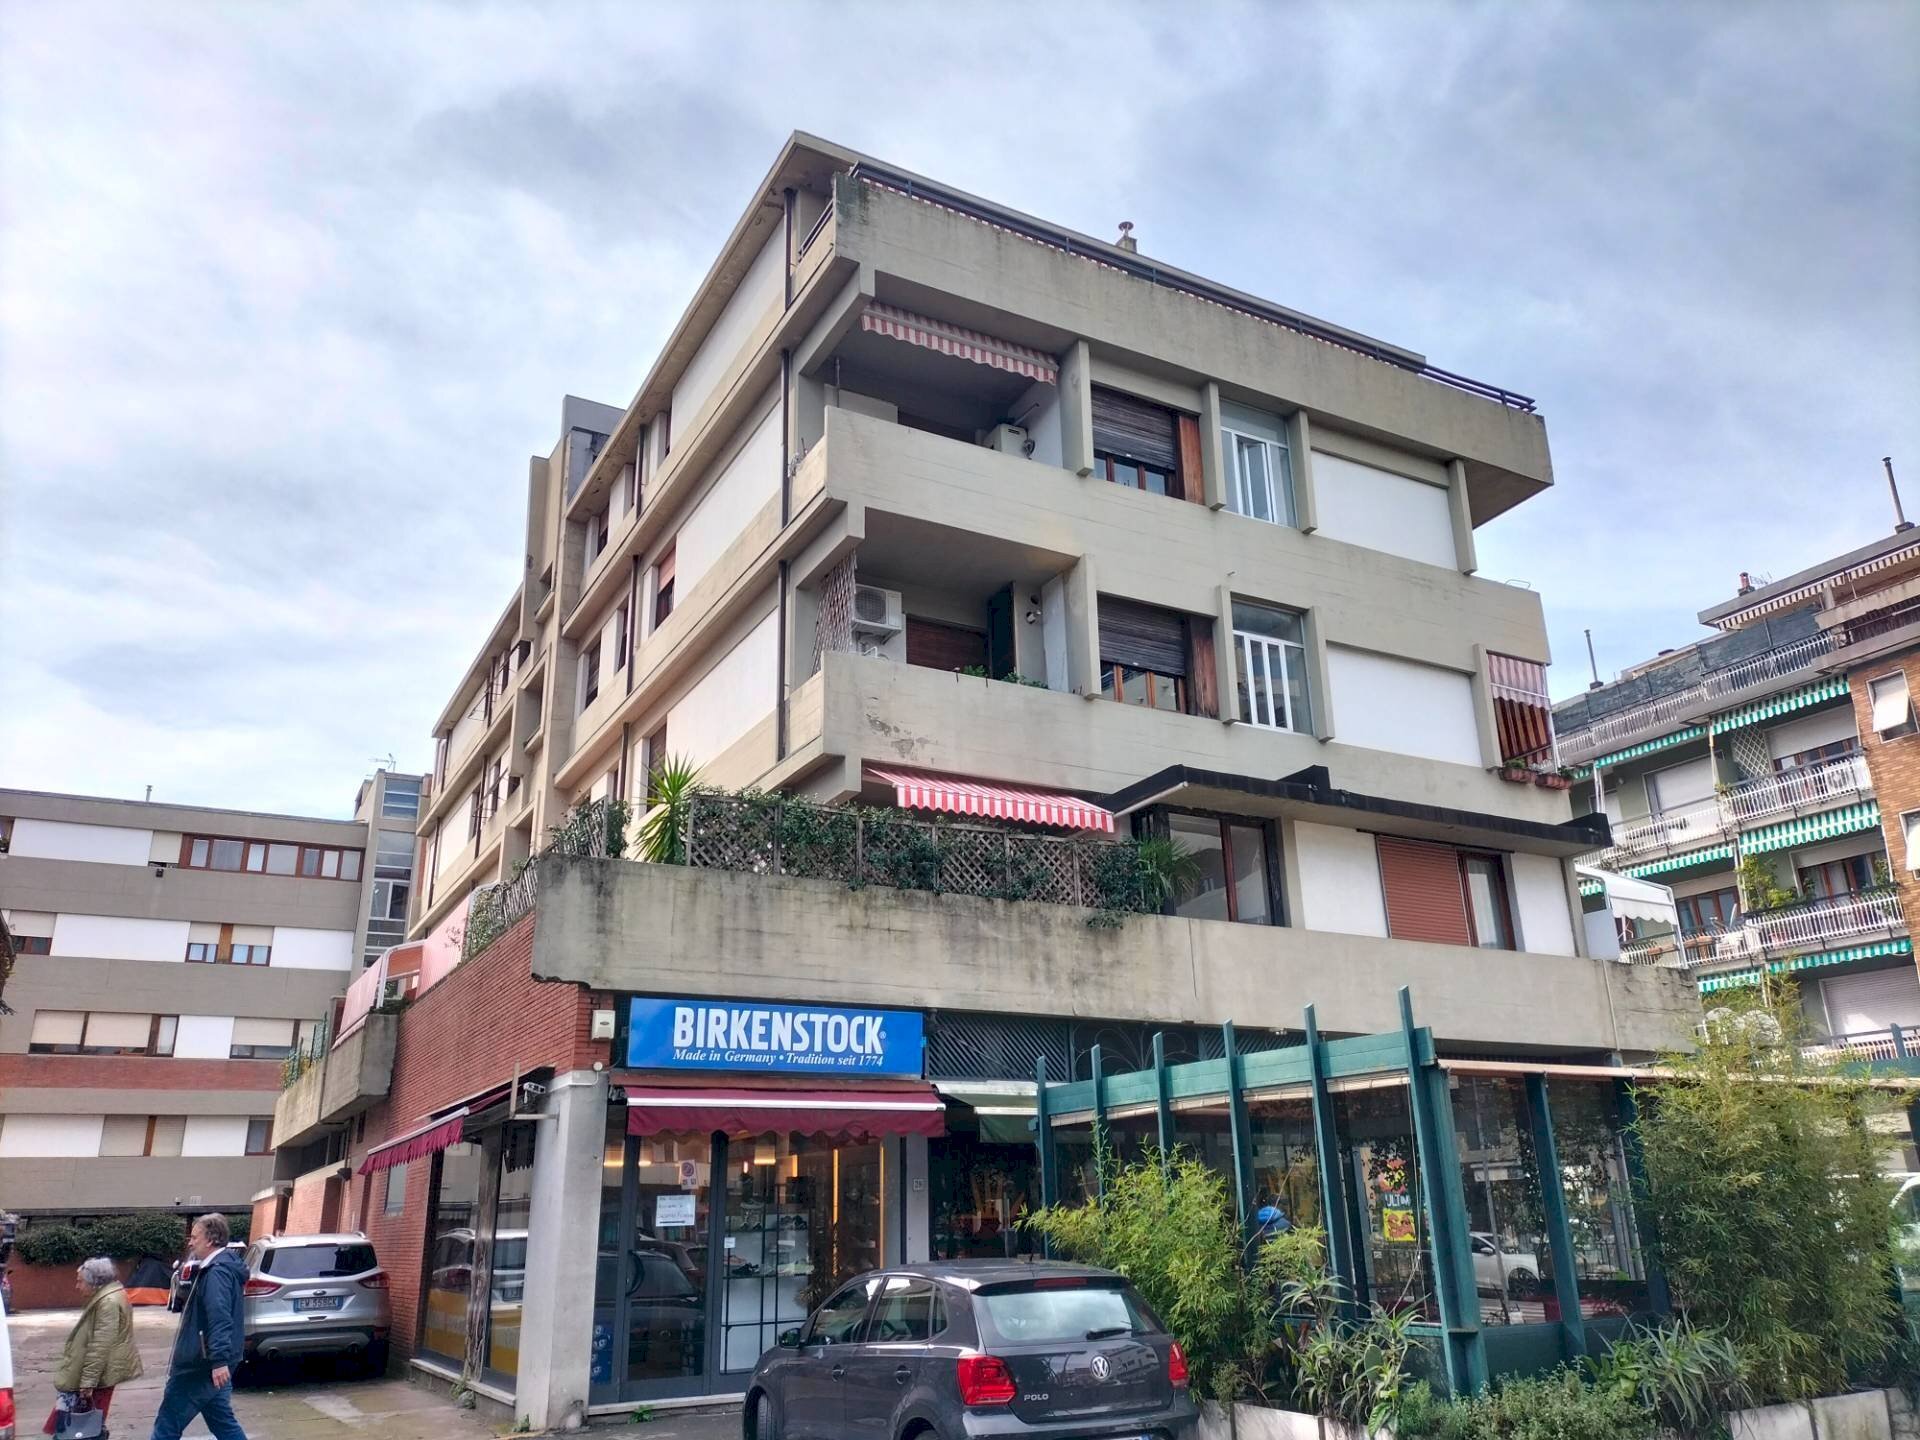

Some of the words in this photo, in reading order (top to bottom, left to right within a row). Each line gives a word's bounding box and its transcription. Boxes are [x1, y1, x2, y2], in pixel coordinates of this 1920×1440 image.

[673, 1006, 884, 1055] BIRKENSTOCK
[672, 1048, 707, 1062] Made
[708, 1050, 721, 1062] in
[724, 1050, 777, 1065] Germany
[786, 1053, 836, 1066] Tradition
[837, 1055, 857, 1067] seit
[858, 1055, 884, 1067] 1774
[1023, 1393, 1049, 1402] POLO
